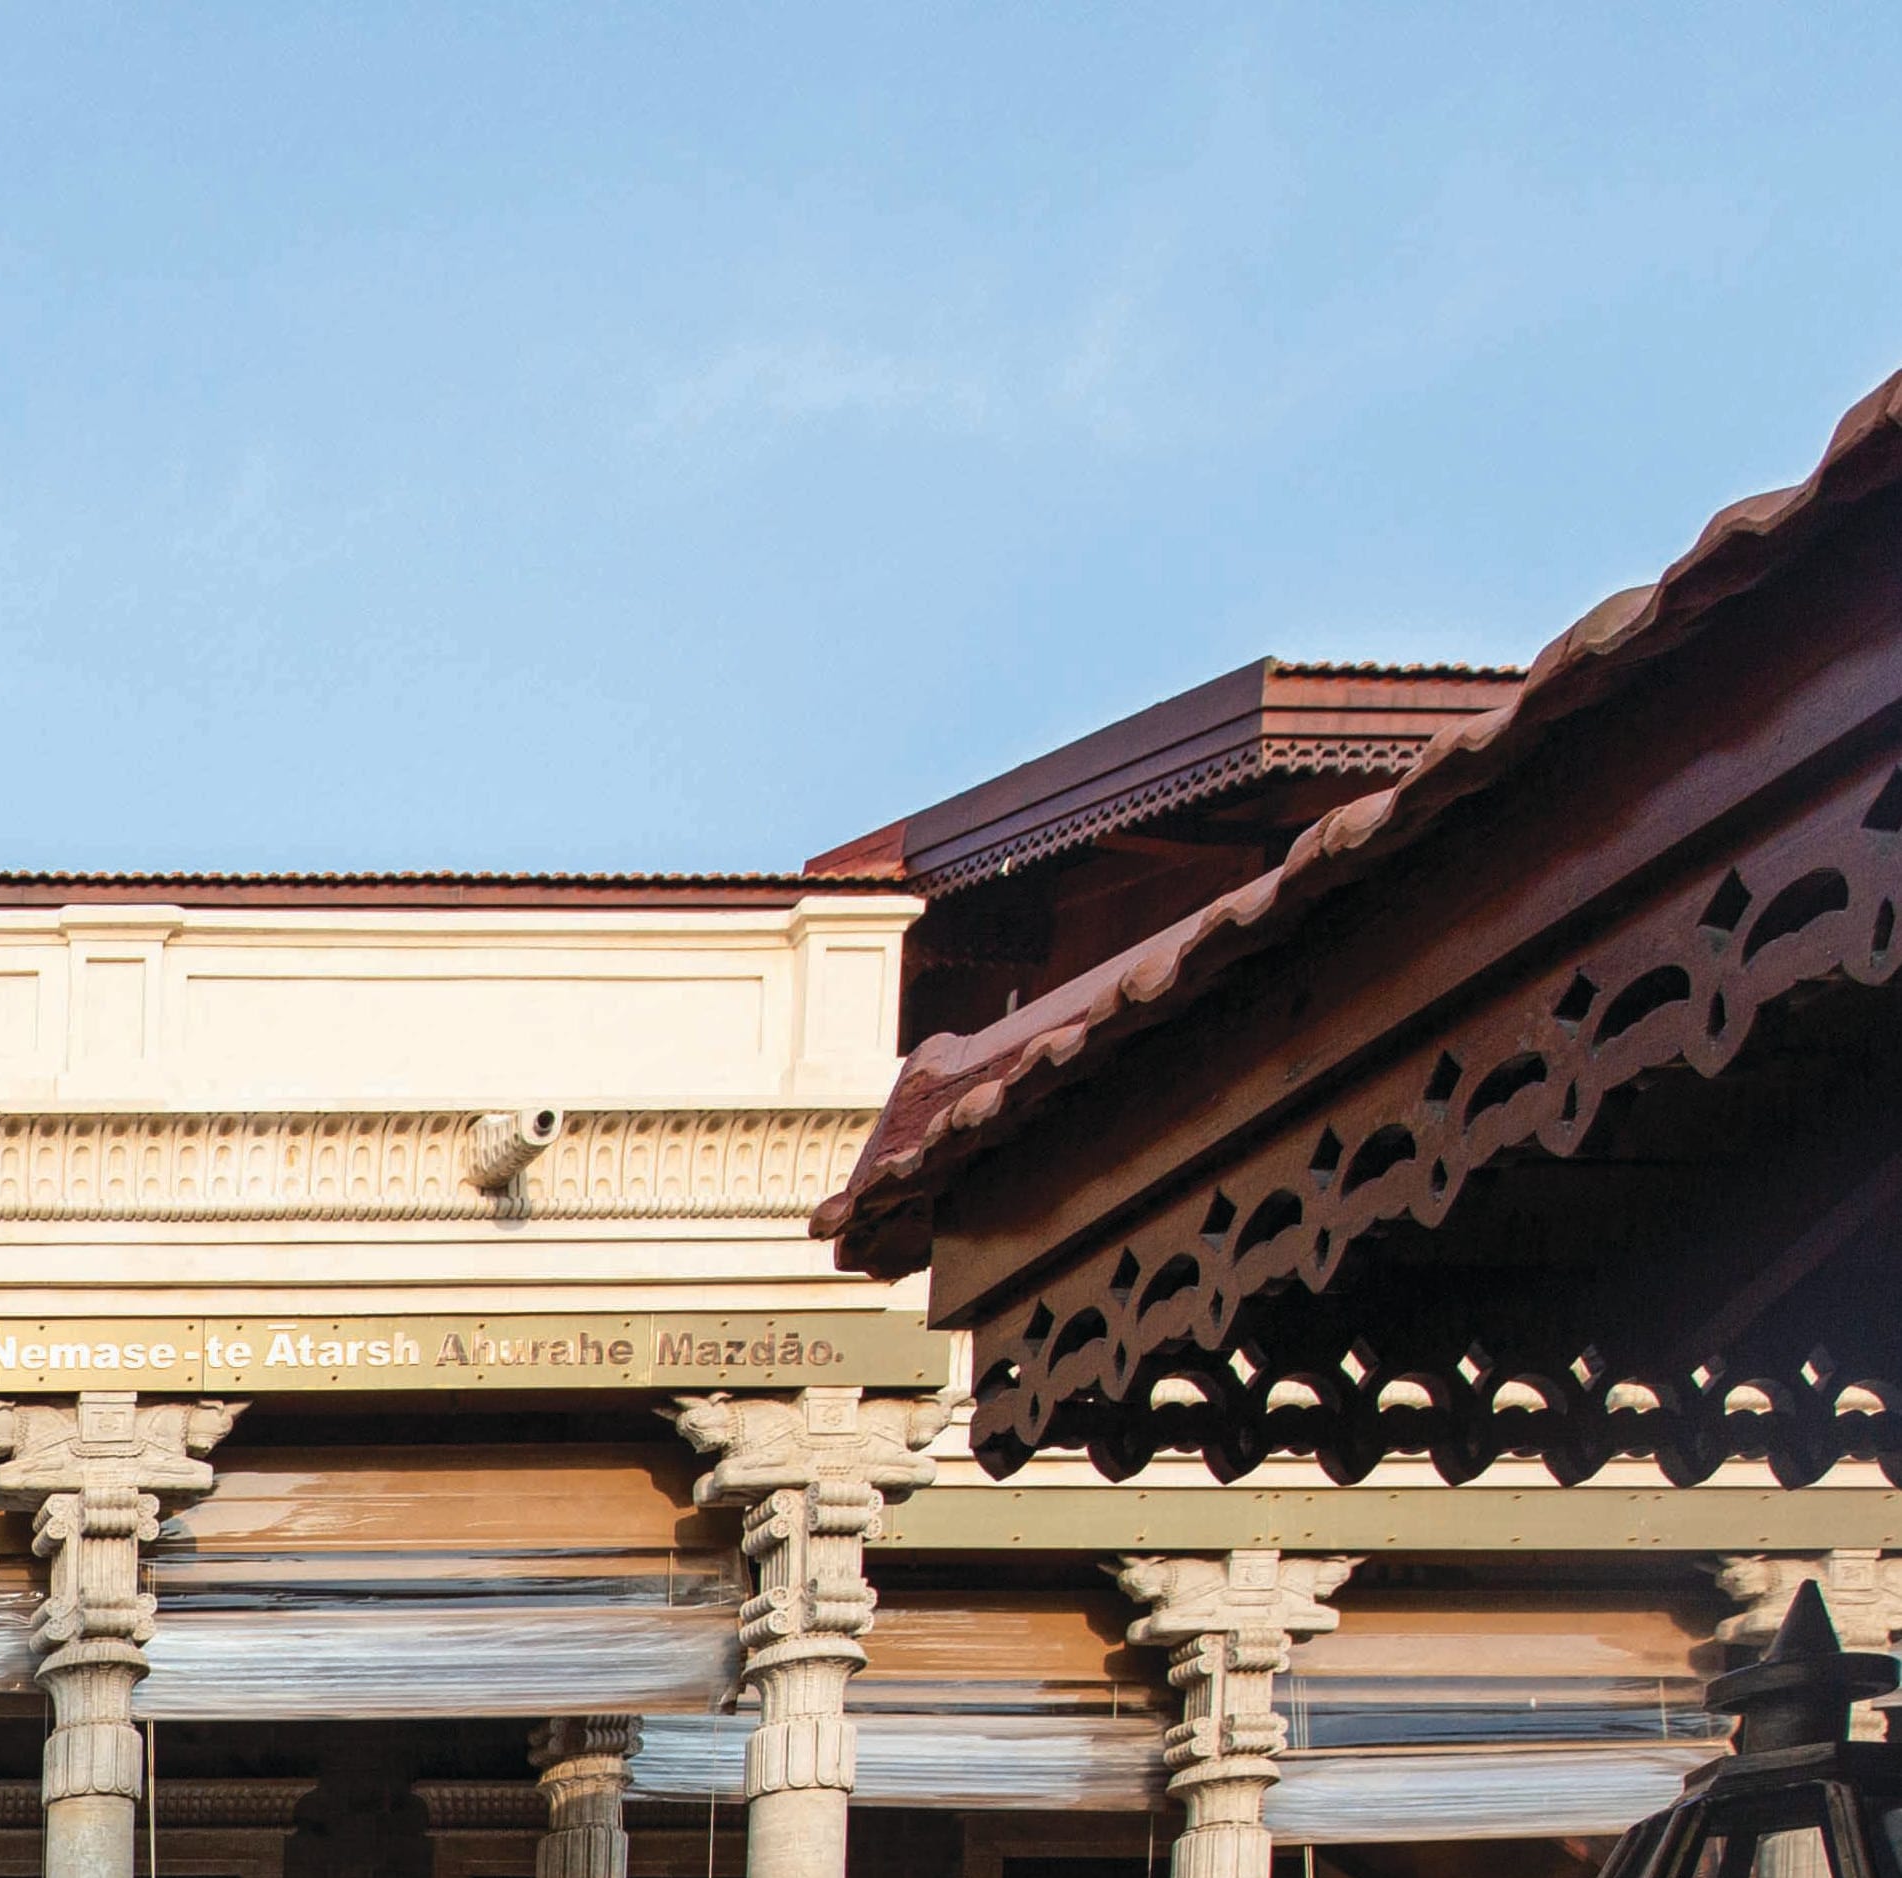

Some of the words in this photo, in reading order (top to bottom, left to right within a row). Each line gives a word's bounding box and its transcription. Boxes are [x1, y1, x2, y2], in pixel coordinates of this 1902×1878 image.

[264, 1323, 422, 1369] Ātarsh
[435, 1331, 635, 1368] Ahurahe
[656, 1331, 845, 1367] Mazdāo.
